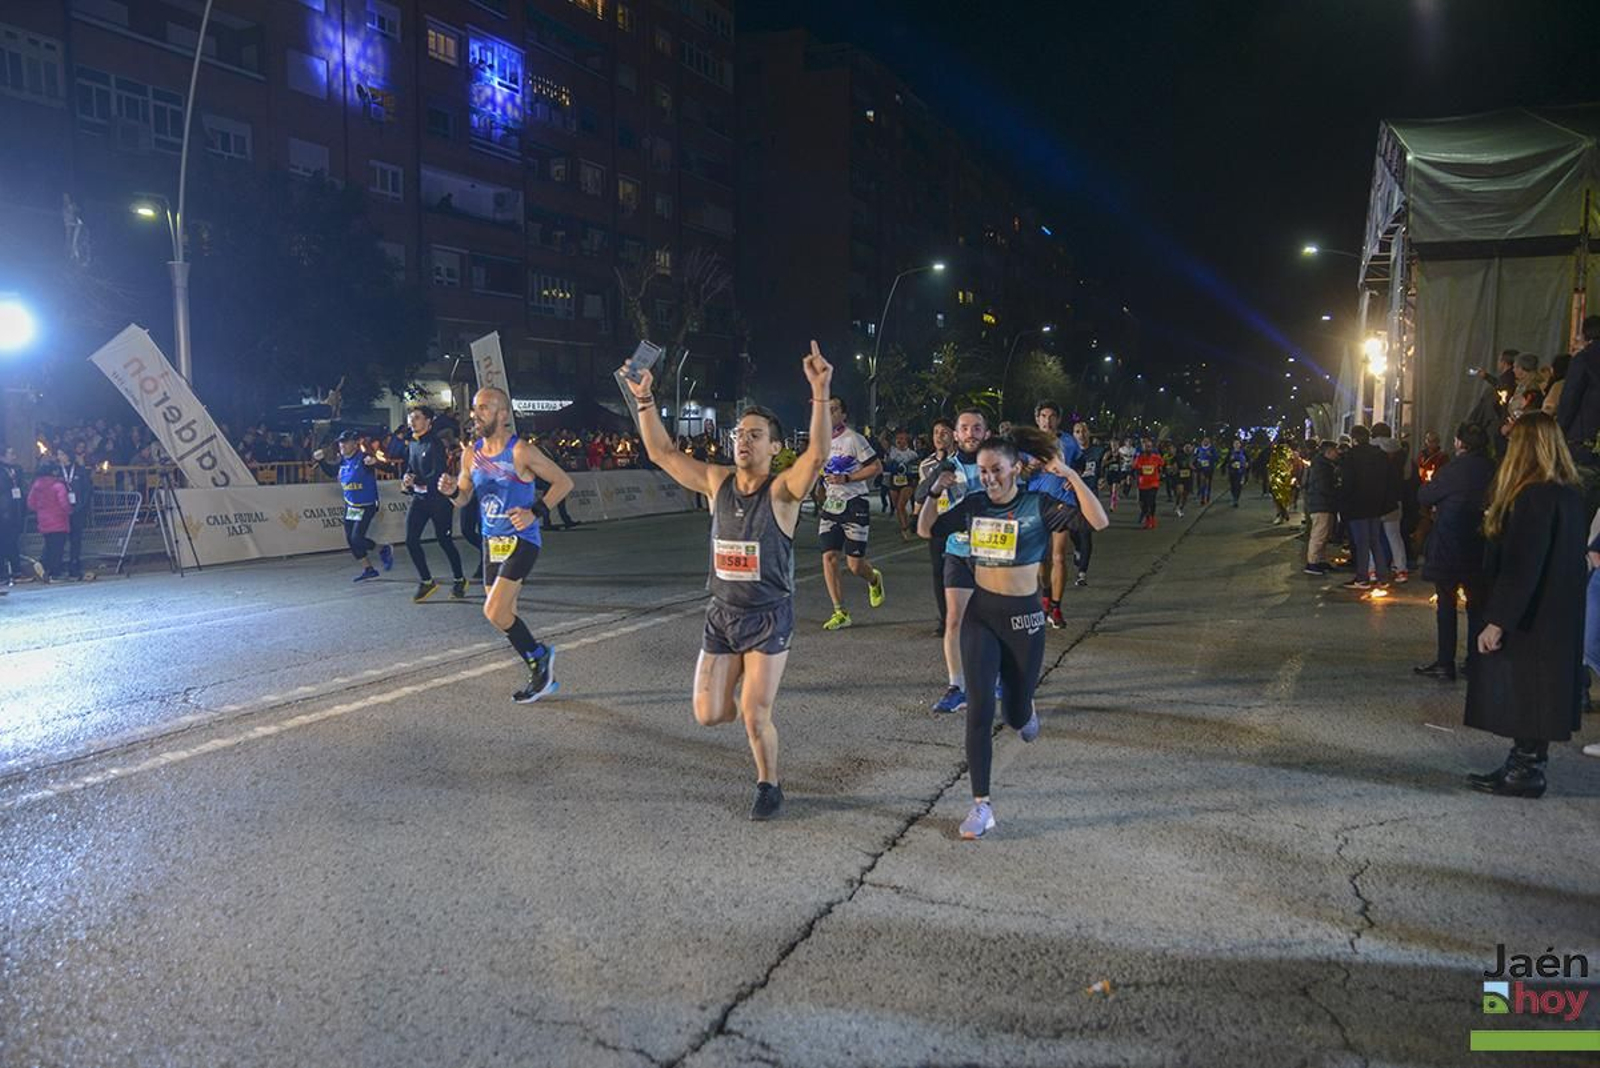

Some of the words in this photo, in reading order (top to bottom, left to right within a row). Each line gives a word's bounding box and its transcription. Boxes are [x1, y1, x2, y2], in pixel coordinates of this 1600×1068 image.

[206, 513, 233, 526] CAJA
[233, 511, 269, 524] RURAL
[303, 507, 327, 519] CAJA
